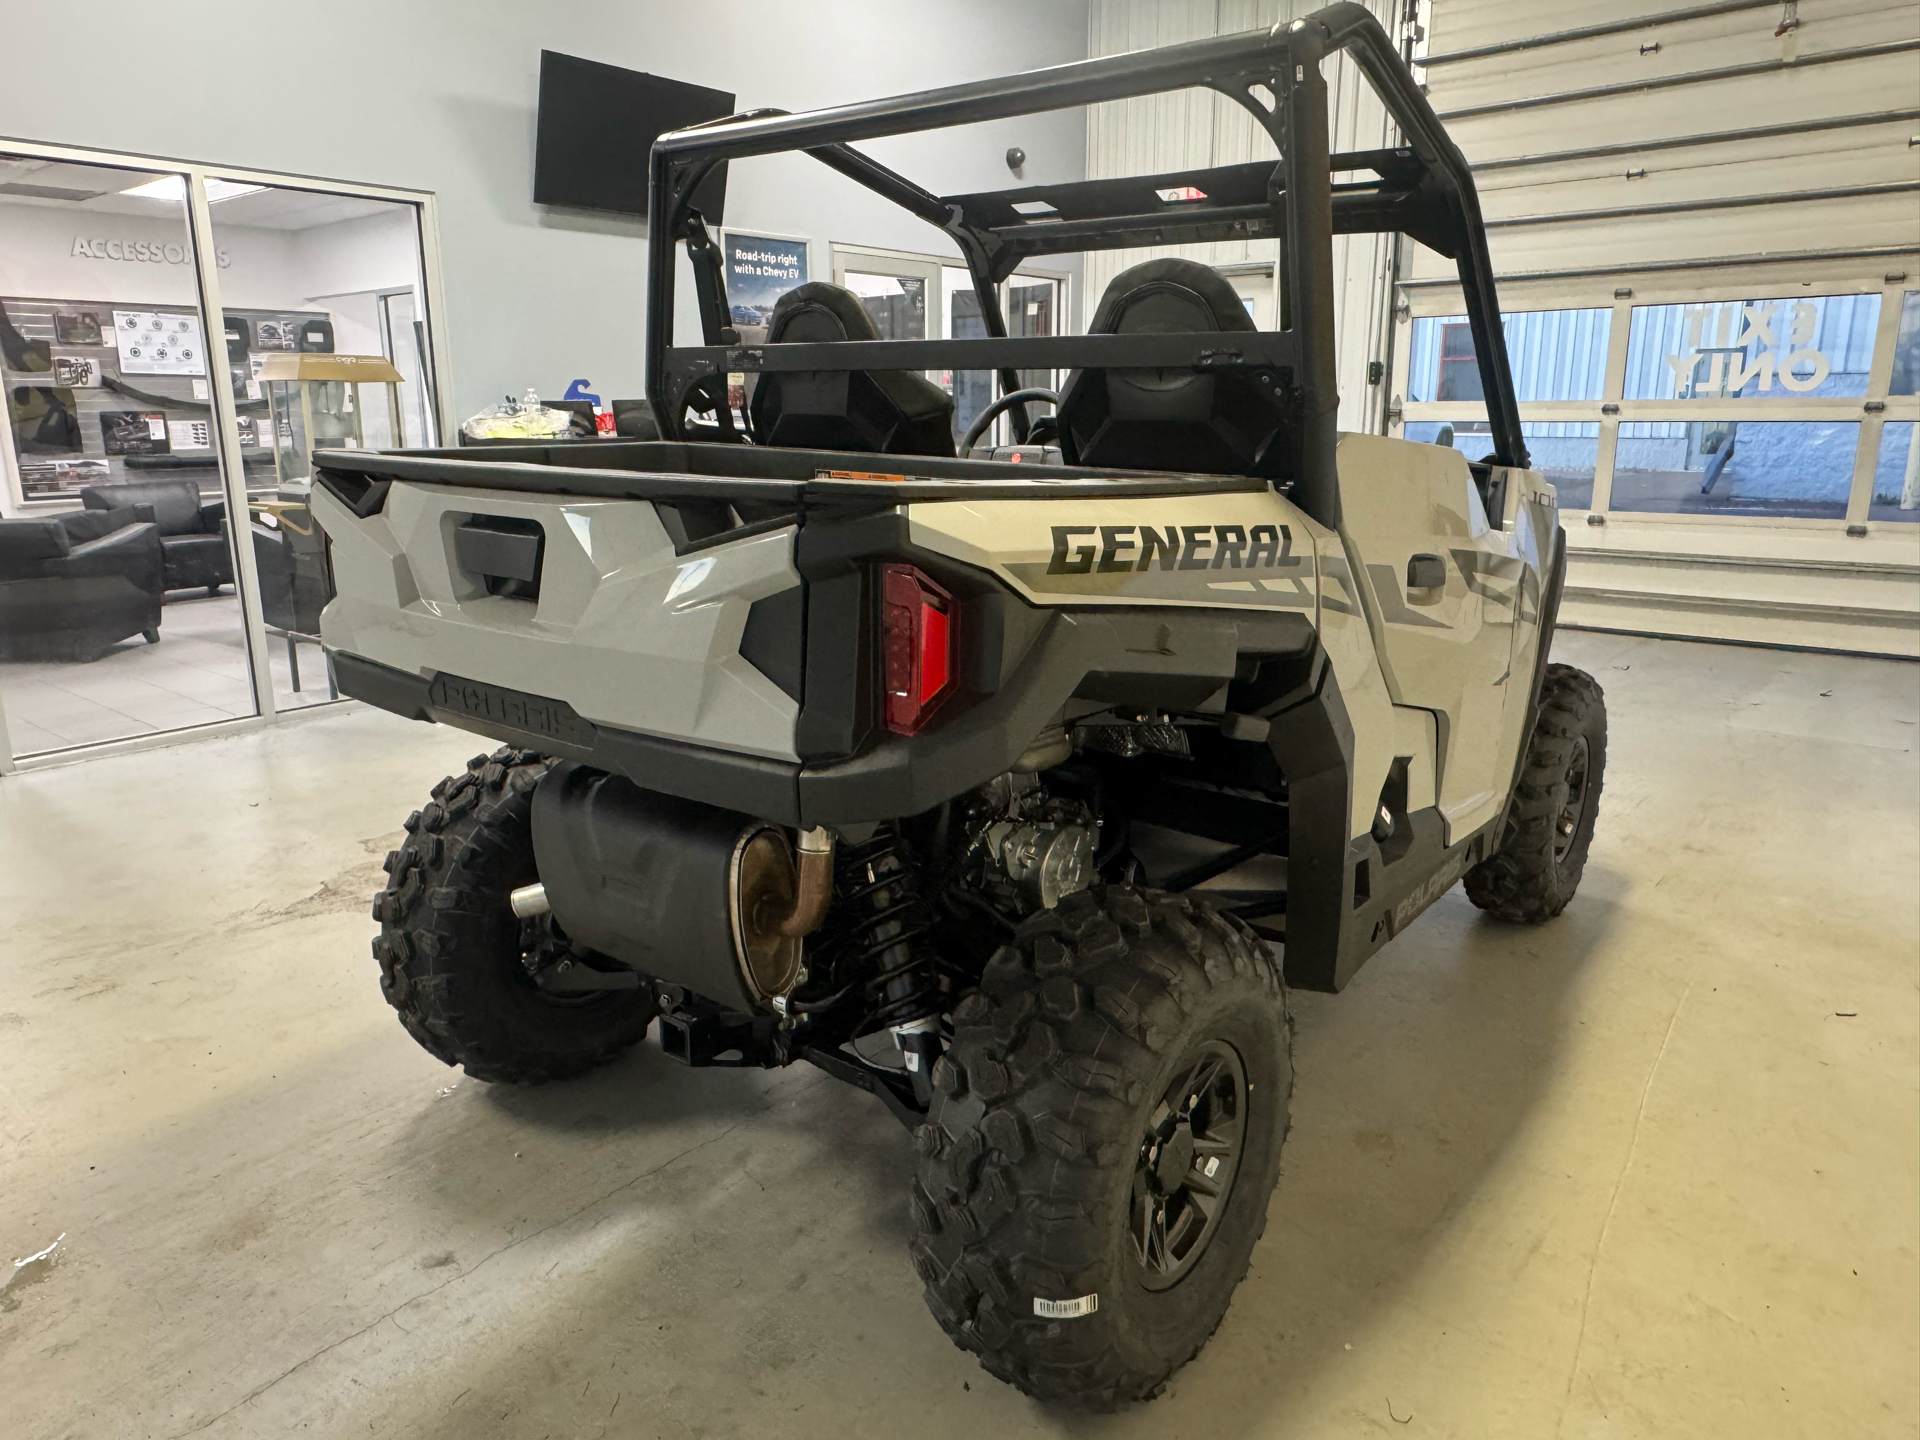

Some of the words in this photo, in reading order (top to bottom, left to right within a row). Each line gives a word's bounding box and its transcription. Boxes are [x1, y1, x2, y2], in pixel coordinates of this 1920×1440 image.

[71, 236, 231, 268] ACCESSOS
[735, 249, 776, 264] Road-trip
[777, 253, 798, 266] right
[734, 263, 755, 275] with
[756, 267, 762, 276] a
[762, 265, 788, 279] Chevy
[789, 268, 799, 279] EV
[1046, 525, 1302, 575] GENERAL
